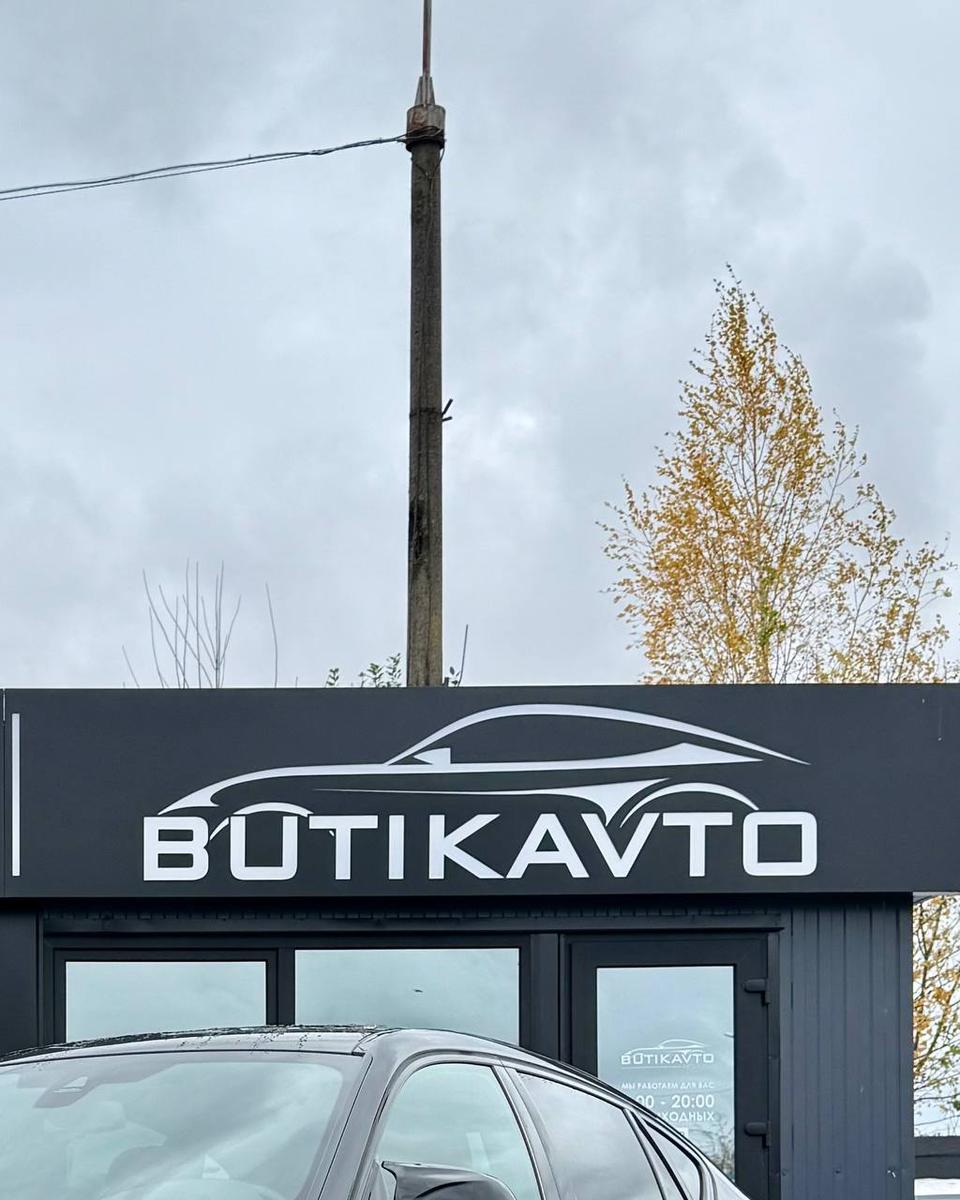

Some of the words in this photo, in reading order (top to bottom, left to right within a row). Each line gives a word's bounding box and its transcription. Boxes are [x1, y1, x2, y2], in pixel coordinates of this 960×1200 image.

[143, 810, 818, 881] BUTIKAVTO
[621, 1053, 715, 1065] BUTIKAVTO
[621, 1082, 635, 1090] МЫ
[637, 1081, 679, 1090] РАБОТАЕМ
[671, 1094, 715, 1109] 20:00
[659, 1111, 715, 1122] ХОДНЫХ
